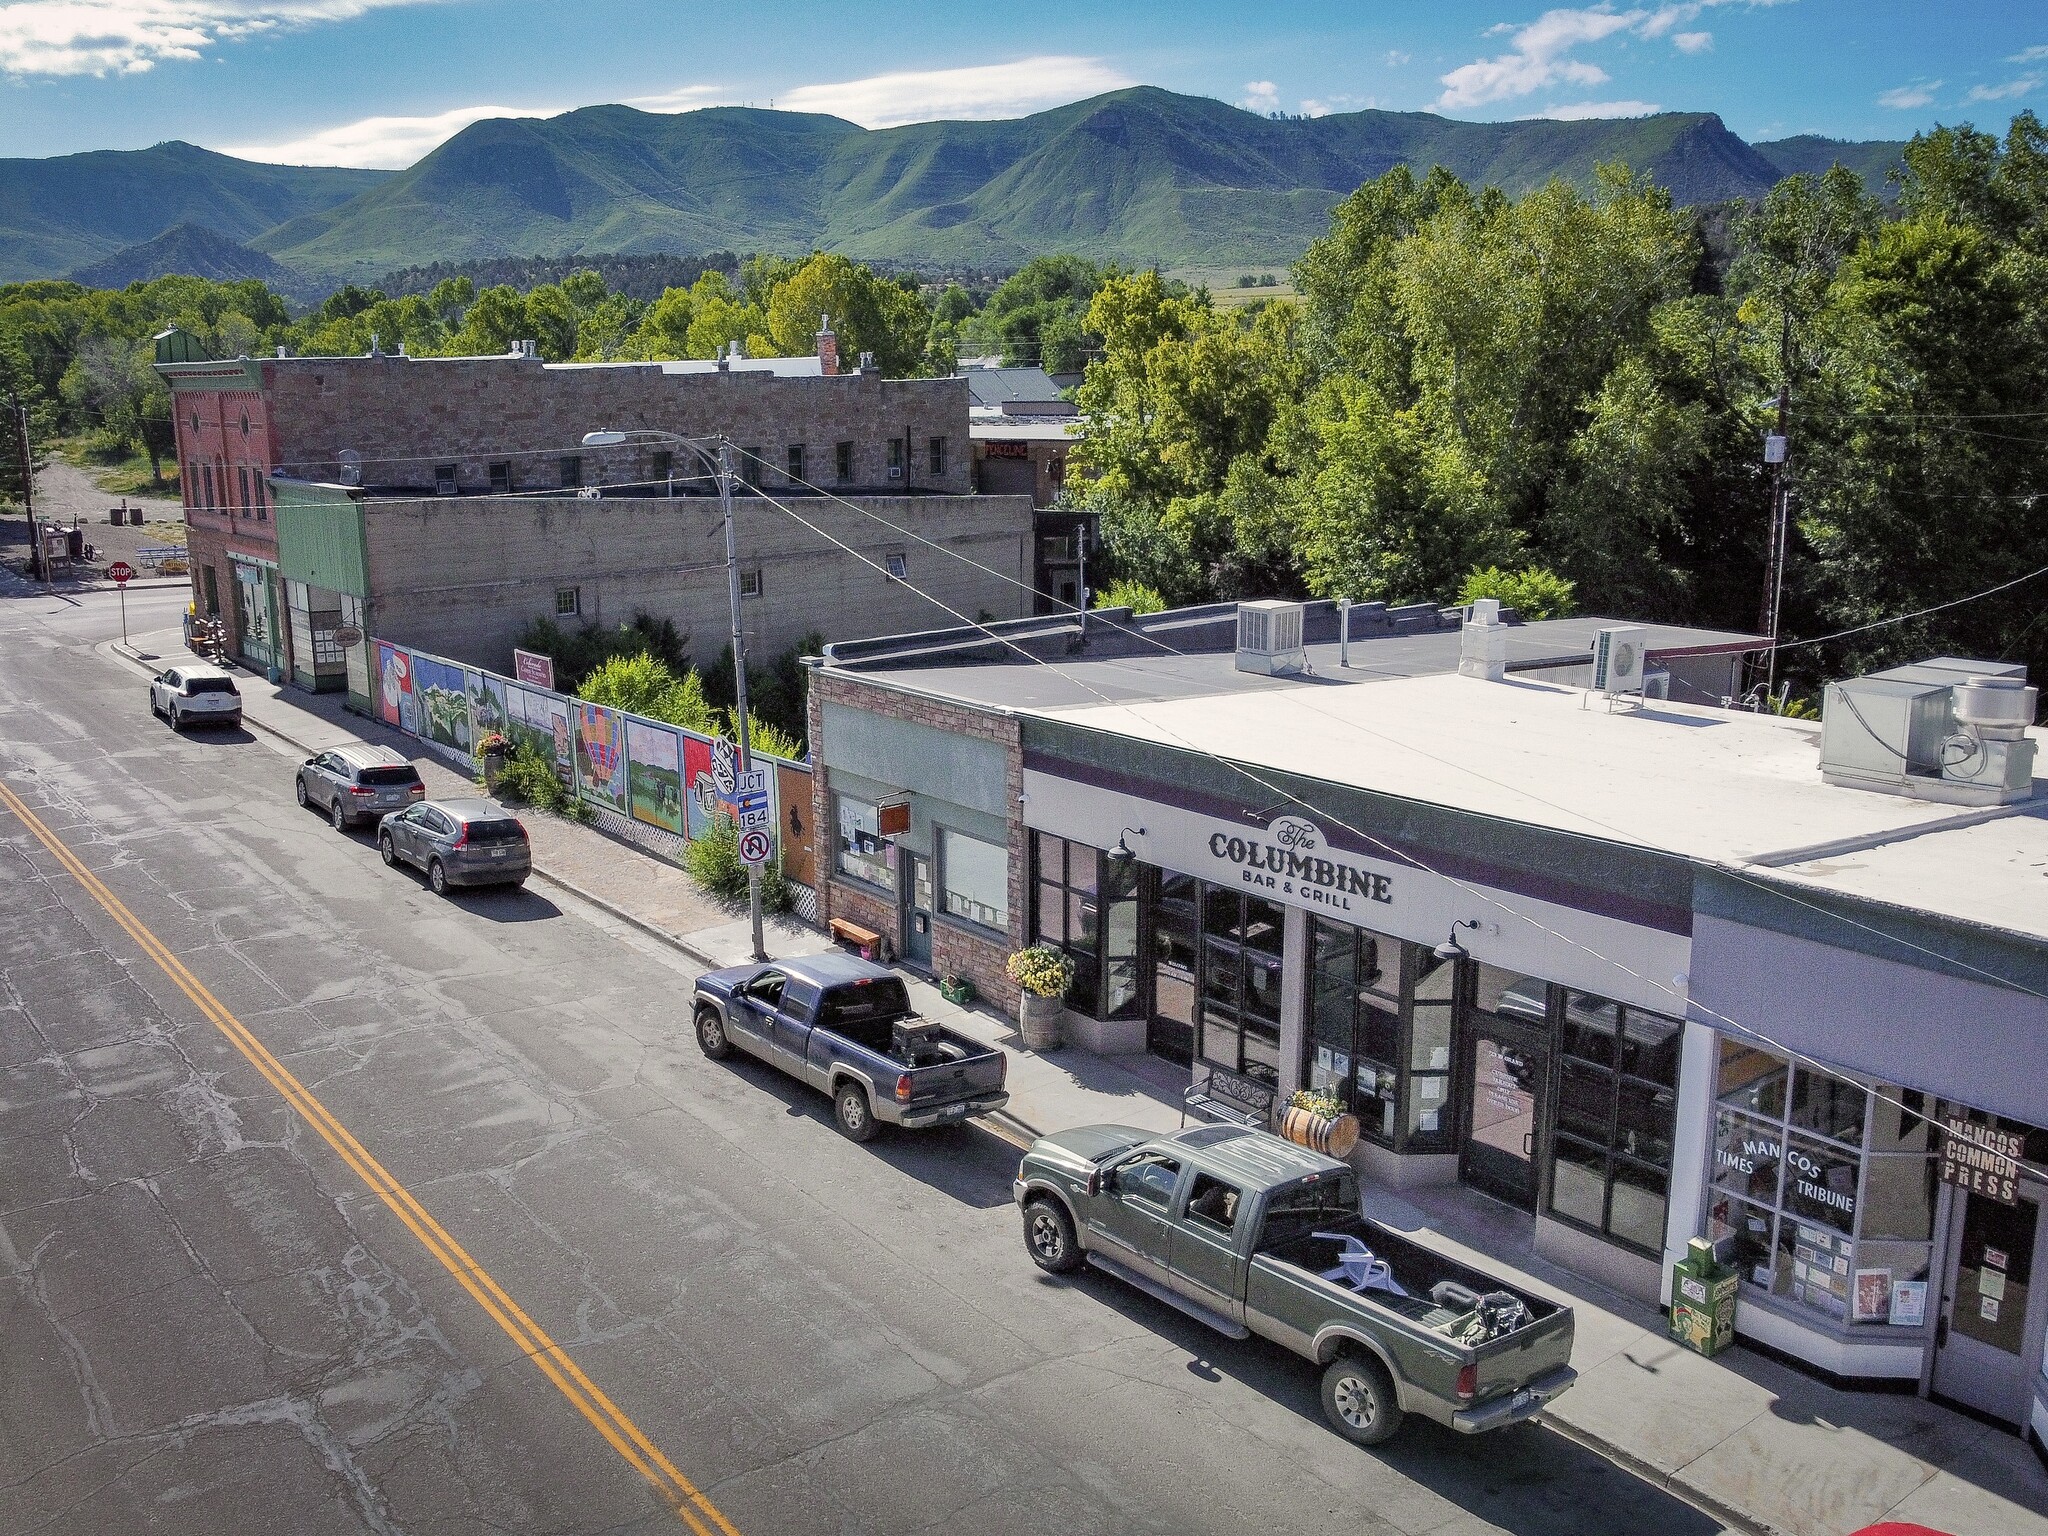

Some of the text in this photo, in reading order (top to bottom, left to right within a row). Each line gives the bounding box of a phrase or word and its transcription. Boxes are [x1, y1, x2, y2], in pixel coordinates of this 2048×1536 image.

[110, 567, 131, 577] STOP
[740, 773, 763, 790] JCT
[740, 810, 767, 827] 184
[1276, 820, 1316, 851] The
[1208, 832, 1393, 905] COLUMBINE
[1242, 869, 1351, 911] BAR & GRILL
[1948, 1119, 2019, 1158] MANCOS
[1742, 1141, 1822, 1179] MANCOS
[1946, 1140, 2017, 1179] COMMON
[1716, 1149, 1854, 1213] TIMES TRIBUNE
[1944, 1161, 2013, 1200] PRESS
